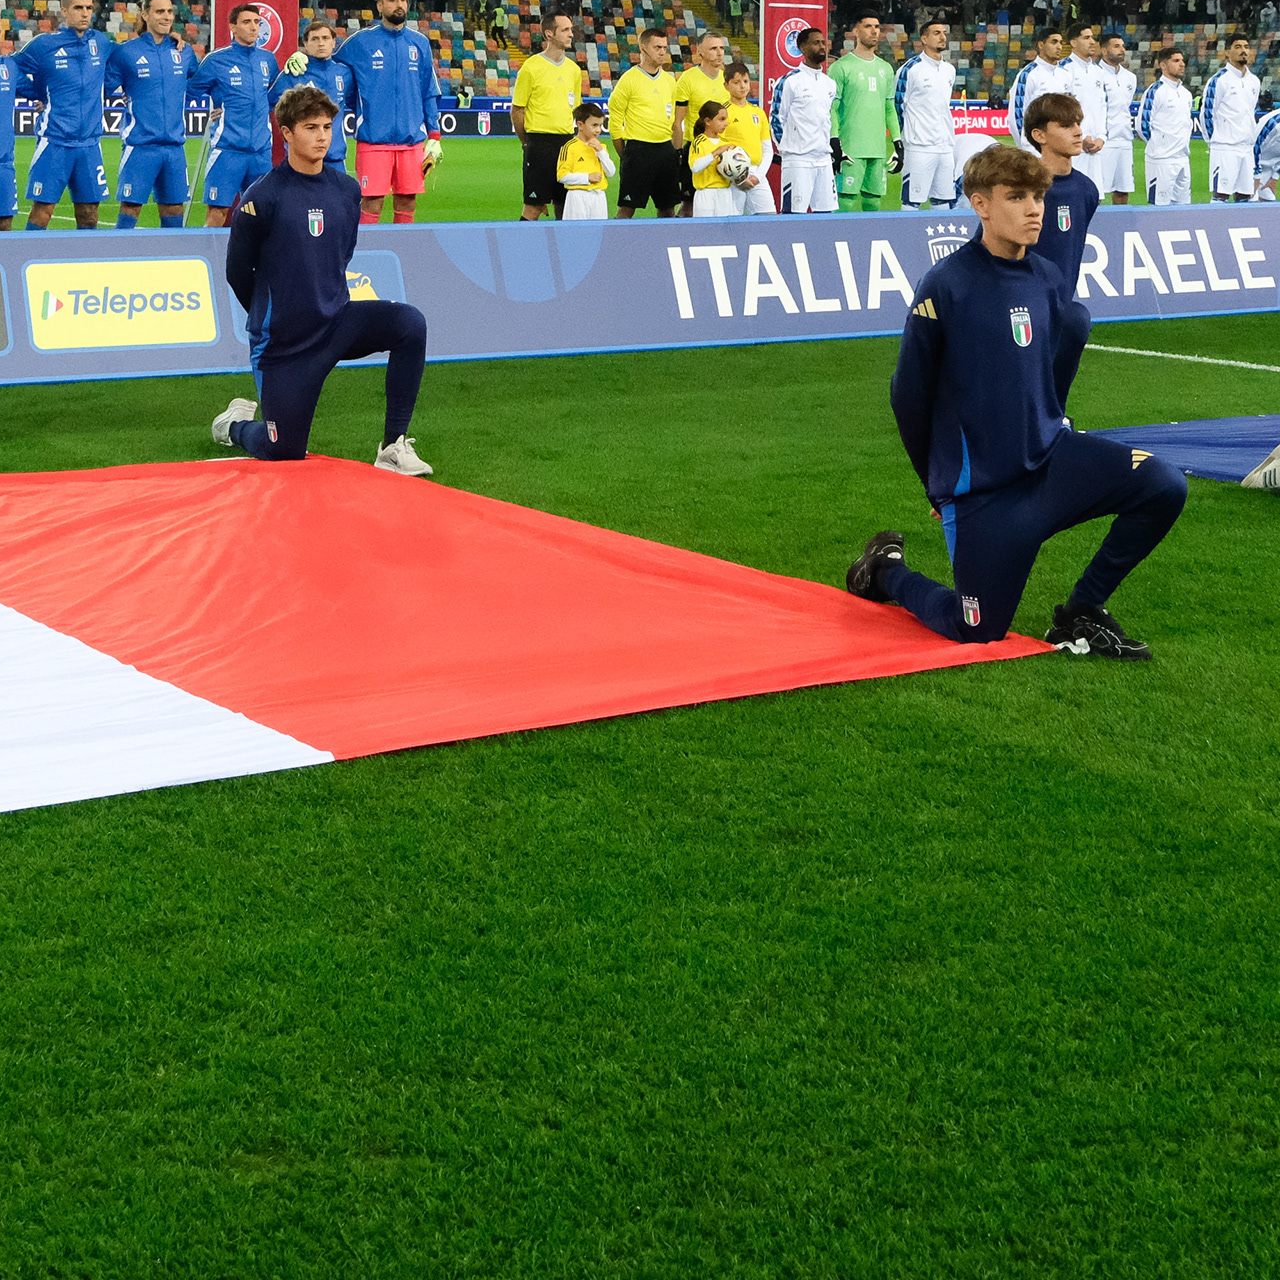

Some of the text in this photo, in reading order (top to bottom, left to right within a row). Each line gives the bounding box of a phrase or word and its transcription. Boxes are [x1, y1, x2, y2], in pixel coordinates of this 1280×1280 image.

[868, 76, 877, 91] 18
[667, 240, 915, 319] ITALIA
[1076, 226, 1276, 298] RAELE
[67, 287, 201, 319] Telepass
